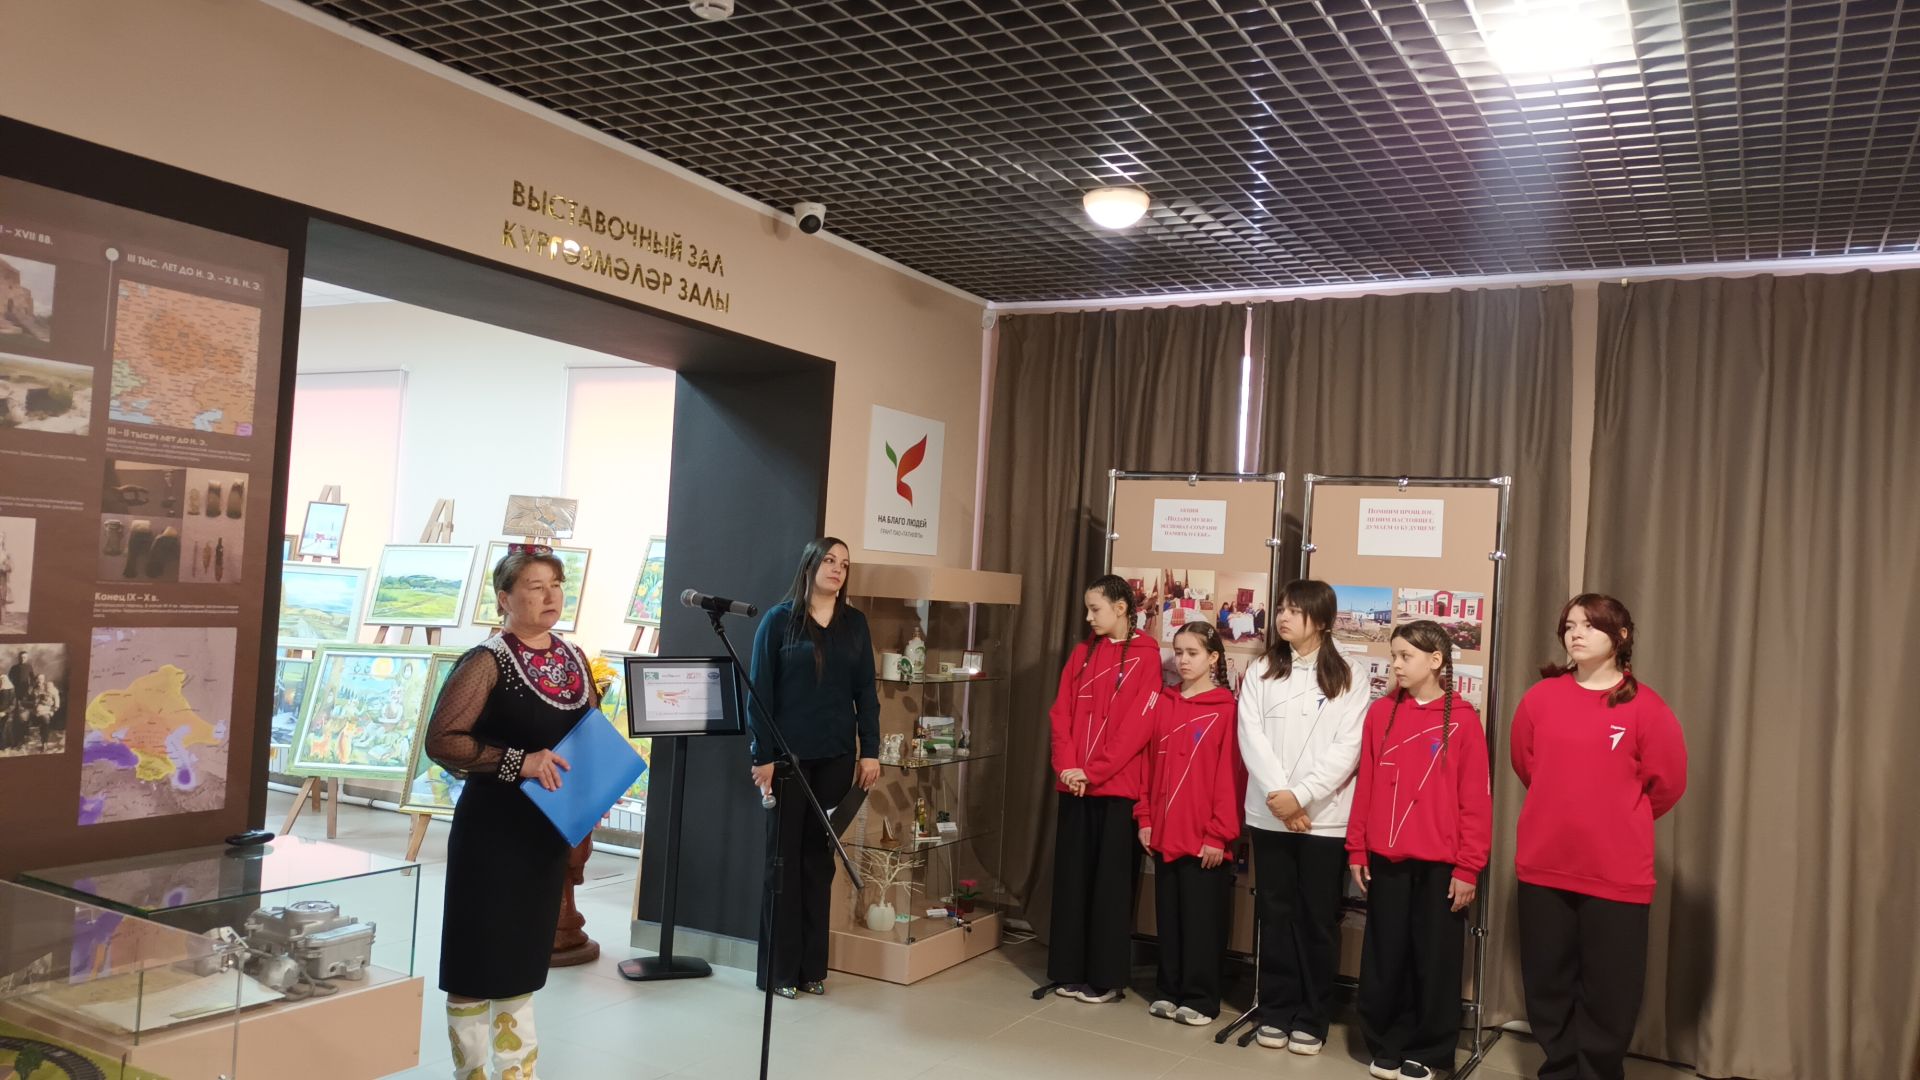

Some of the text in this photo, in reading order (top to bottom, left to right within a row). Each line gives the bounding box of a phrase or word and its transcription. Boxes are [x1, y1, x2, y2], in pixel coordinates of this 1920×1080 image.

[512, 180, 724, 277] ВЫСТАВОЧНЫЙ ЗАЛ
[127, 253, 136, 263] III
[137, 255, 159, 269] ТЫС.
[161, 261, 177, 272] ЛЕТ
[178, 266, 194, 276] ДО
[207, 271, 216, 281] Э.
[678, 278, 730, 313] ЗАЛЫ
[160, 435, 176, 443] ЛЕТ
[176, 436, 189, 444] ДО
[878, 515, 927, 528] НА БЛАГО ЛЮДЕЙ
[94, 592, 126, 603] Конец
